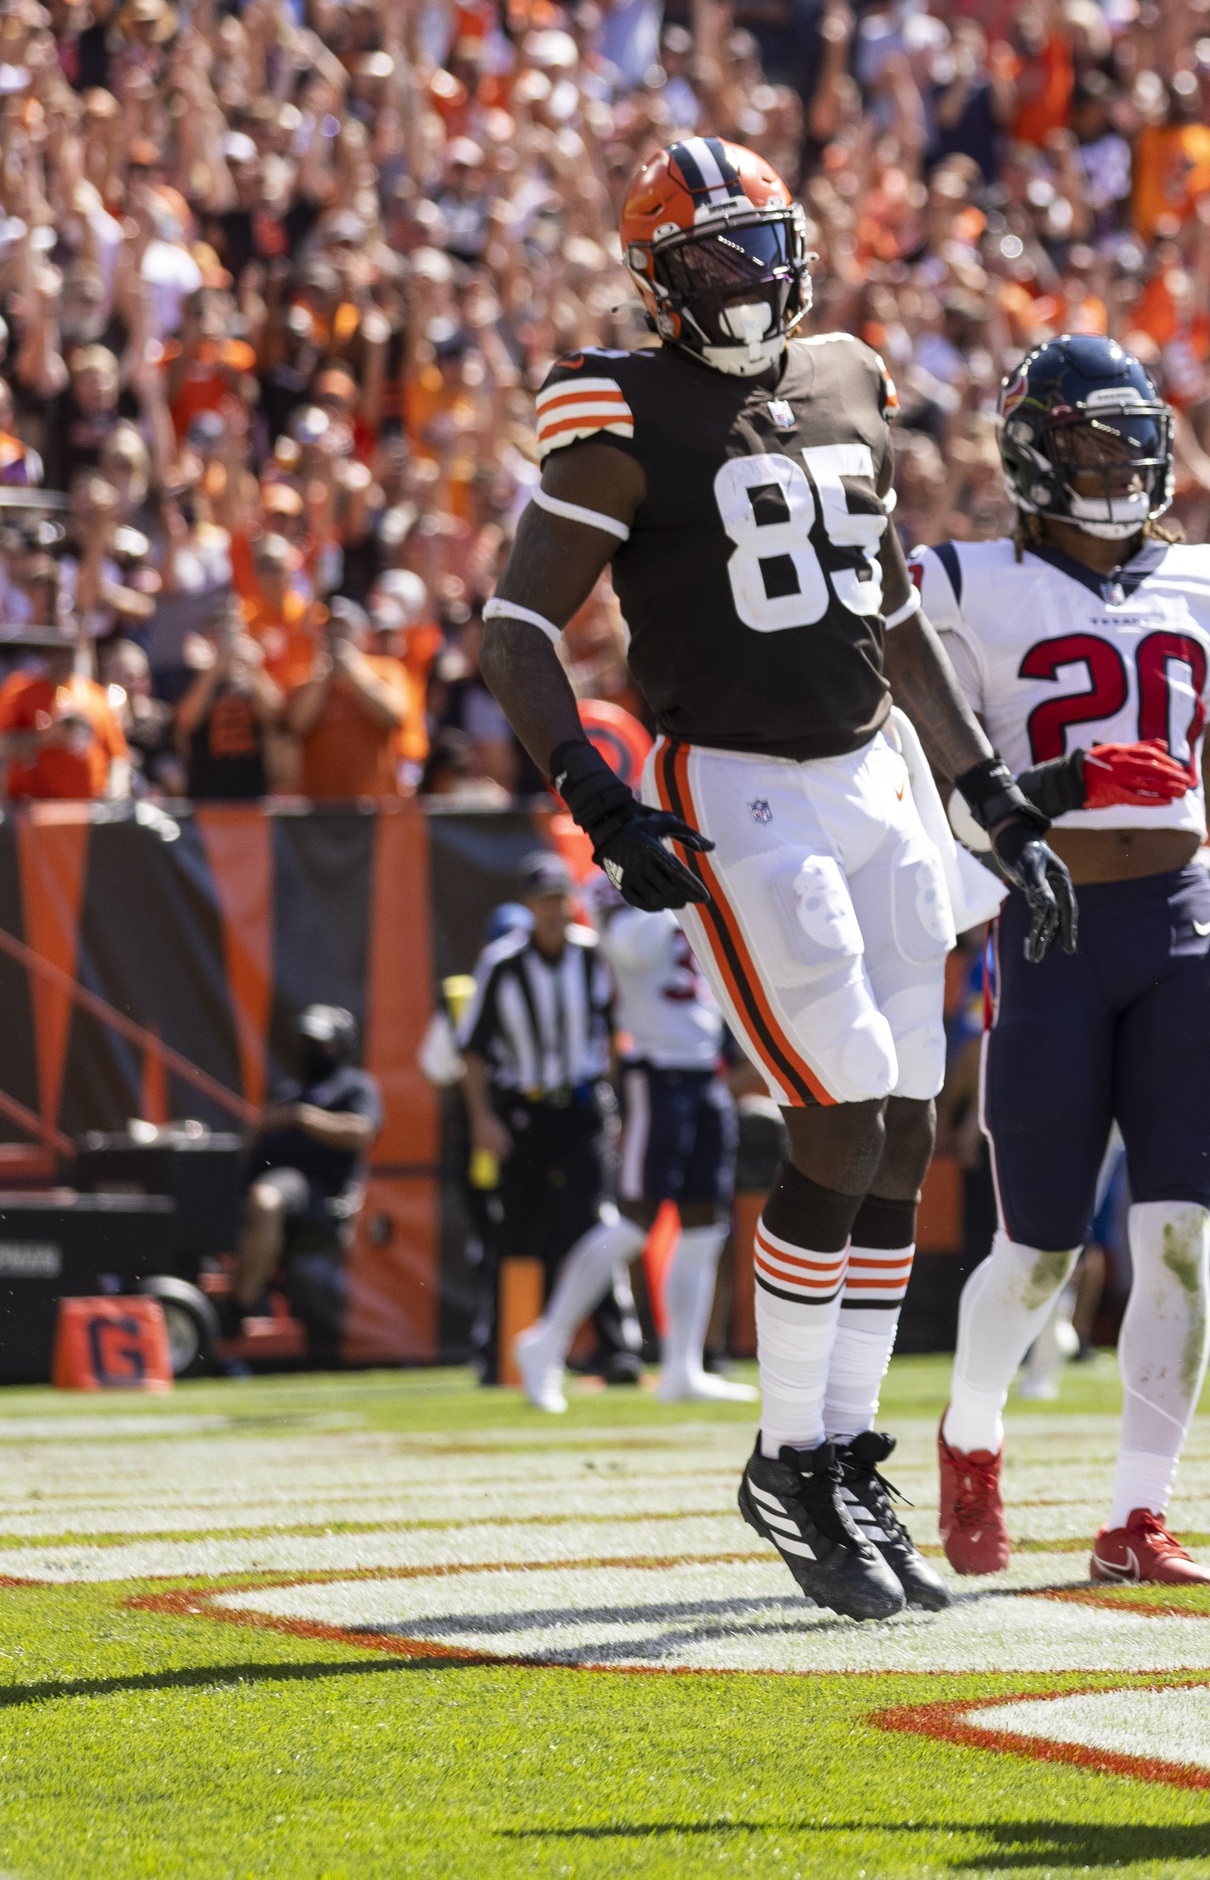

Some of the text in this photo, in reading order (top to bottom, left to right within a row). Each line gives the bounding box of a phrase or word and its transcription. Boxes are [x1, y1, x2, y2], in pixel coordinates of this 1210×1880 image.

[713, 443, 888, 633] 85
[1018, 630, 1208, 790] 20
[86, 1314, 146, 1388] G
